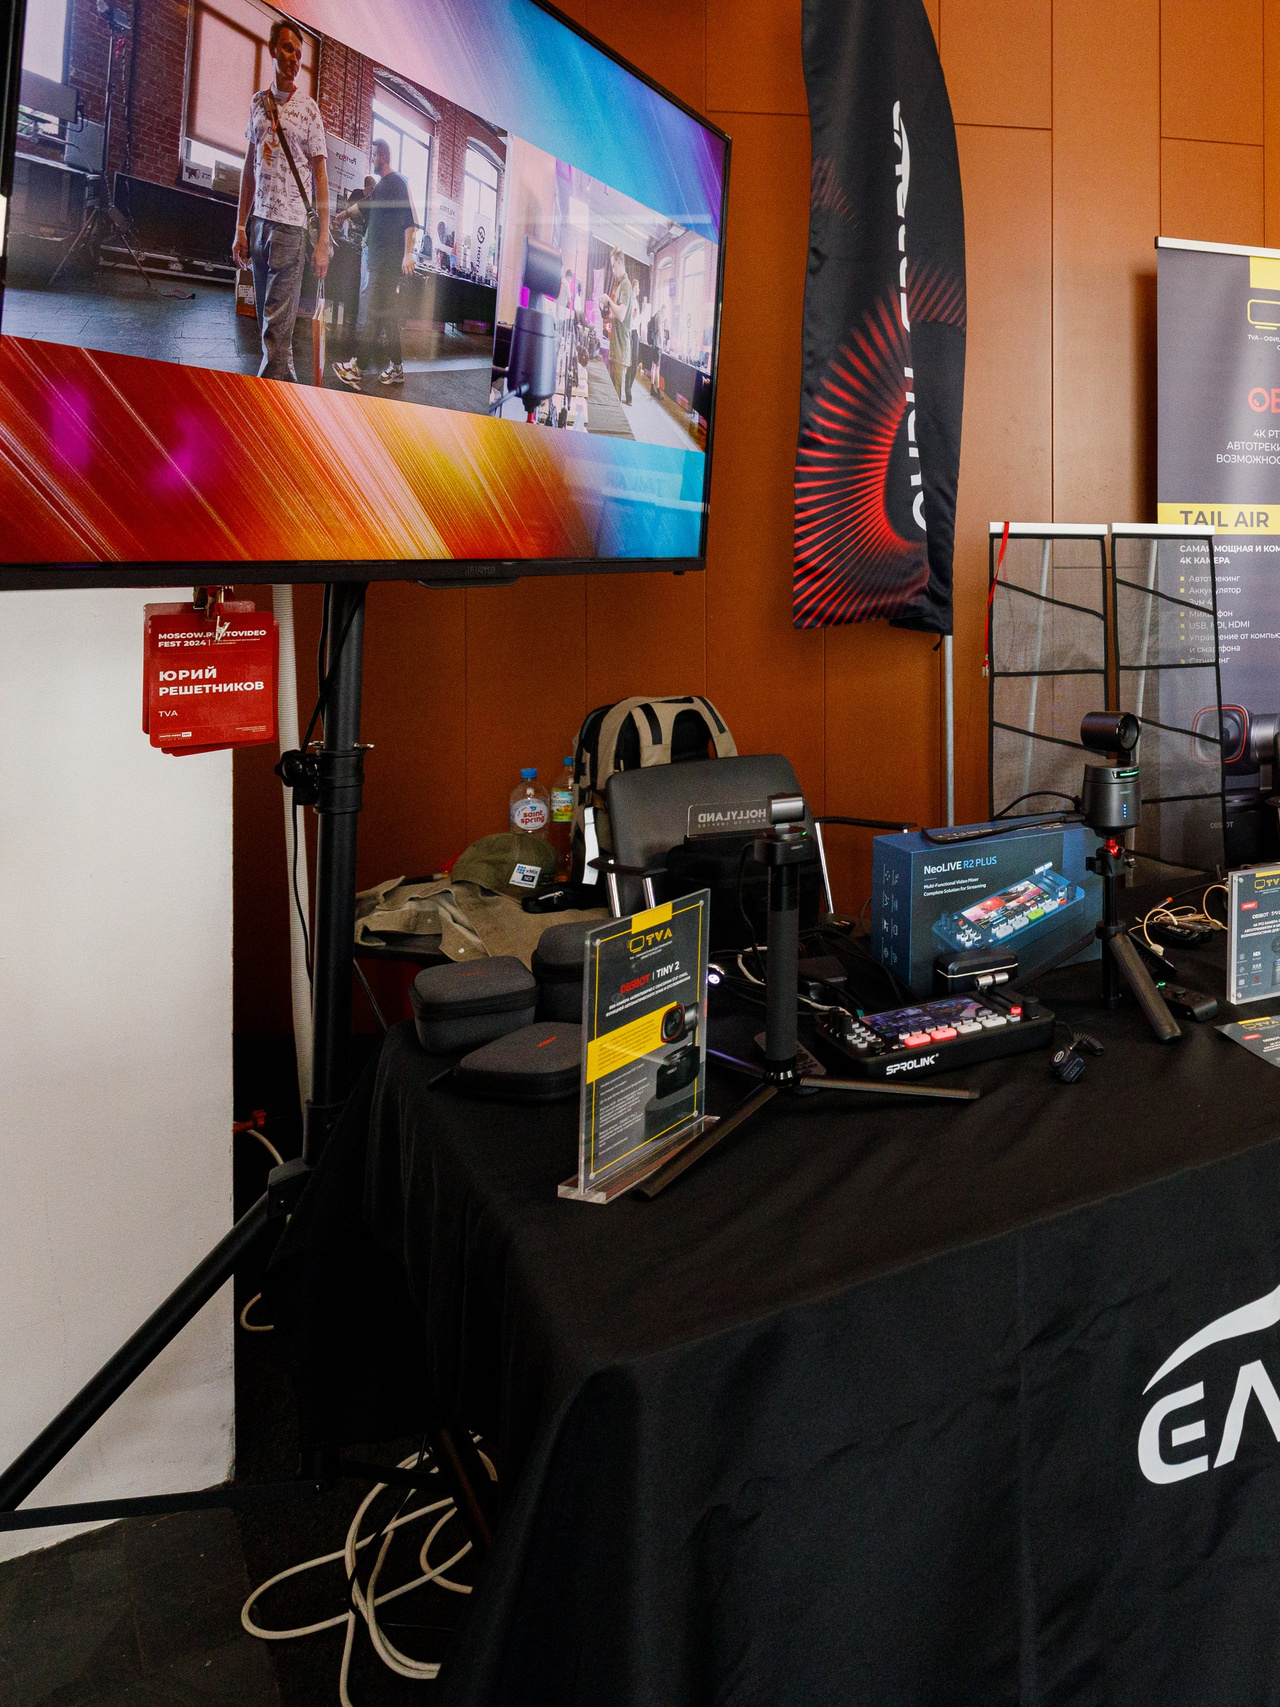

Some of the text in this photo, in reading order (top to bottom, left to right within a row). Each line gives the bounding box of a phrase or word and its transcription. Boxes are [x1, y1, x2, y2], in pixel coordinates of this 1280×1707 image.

[1180, 510, 1270, 528] TAIL AIR
[1214, 545, 1254, 554] МОЩНАЯ
[1188, 575, 1241, 583] Автотекинг
[1189, 609, 1233, 618] Микфон
[158, 629, 267, 640] MOSCOW.PTOVIDEO
[1189, 633, 1239, 642] Управение
[158, 640, 182, 648] FEST
[159, 665, 217, 681] ЮРИЙ
[159, 681, 265, 697] РЕШЕТНИКОВ
[158, 710, 179, 718] TVA
[523, 810, 544, 818] saint
[520, 815, 545, 825] spring
[923, 855, 998, 875] NeoLIVE R2 PLUS
[645, 927, 673, 946] TVA
[655, 963, 674, 979] TINY
[674, 961, 680, 971] 2
[885, 1054, 936, 1076] SPROLINK
